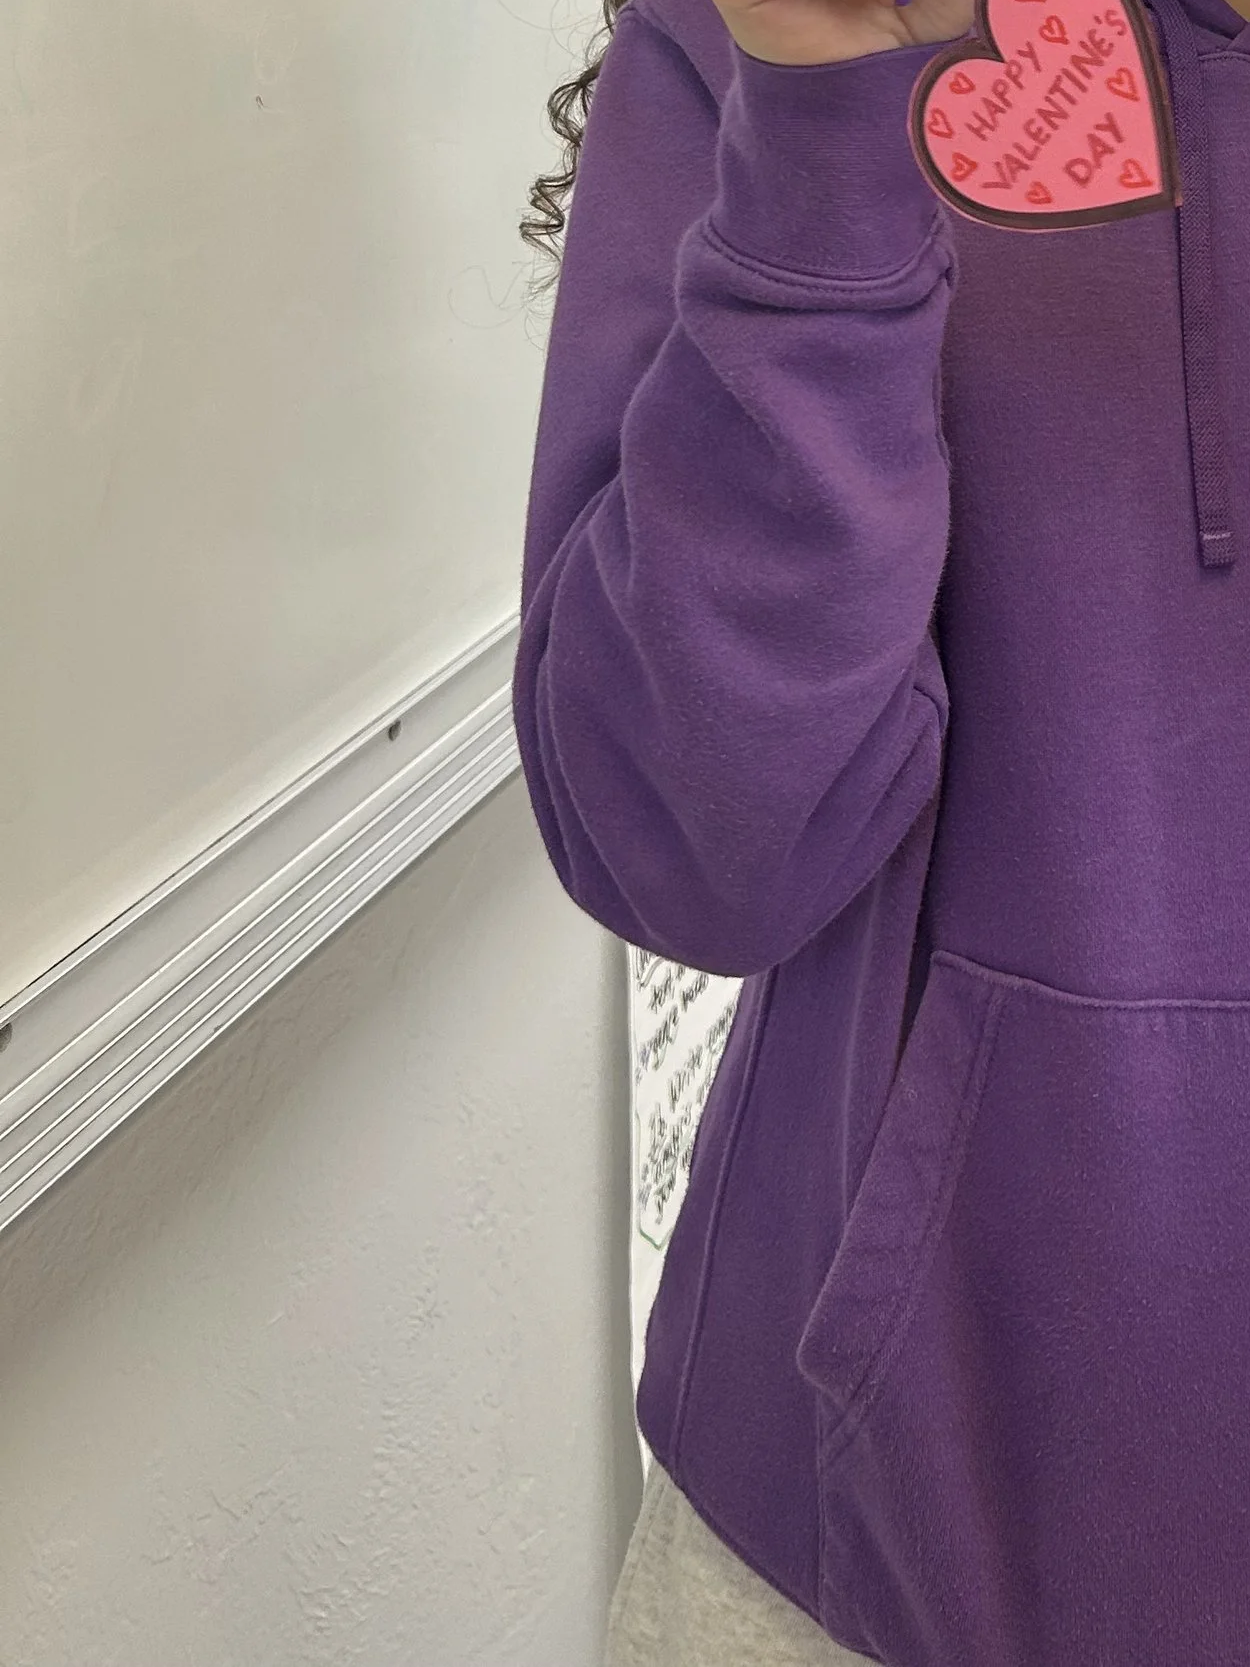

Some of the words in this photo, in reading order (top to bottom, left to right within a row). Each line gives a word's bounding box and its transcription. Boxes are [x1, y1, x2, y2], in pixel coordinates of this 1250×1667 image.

[964, 40, 1043, 142] HAPPY
[981, 9, 1128, 190] VALENTINE'S
[1063, 111, 1126, 188] DAY
